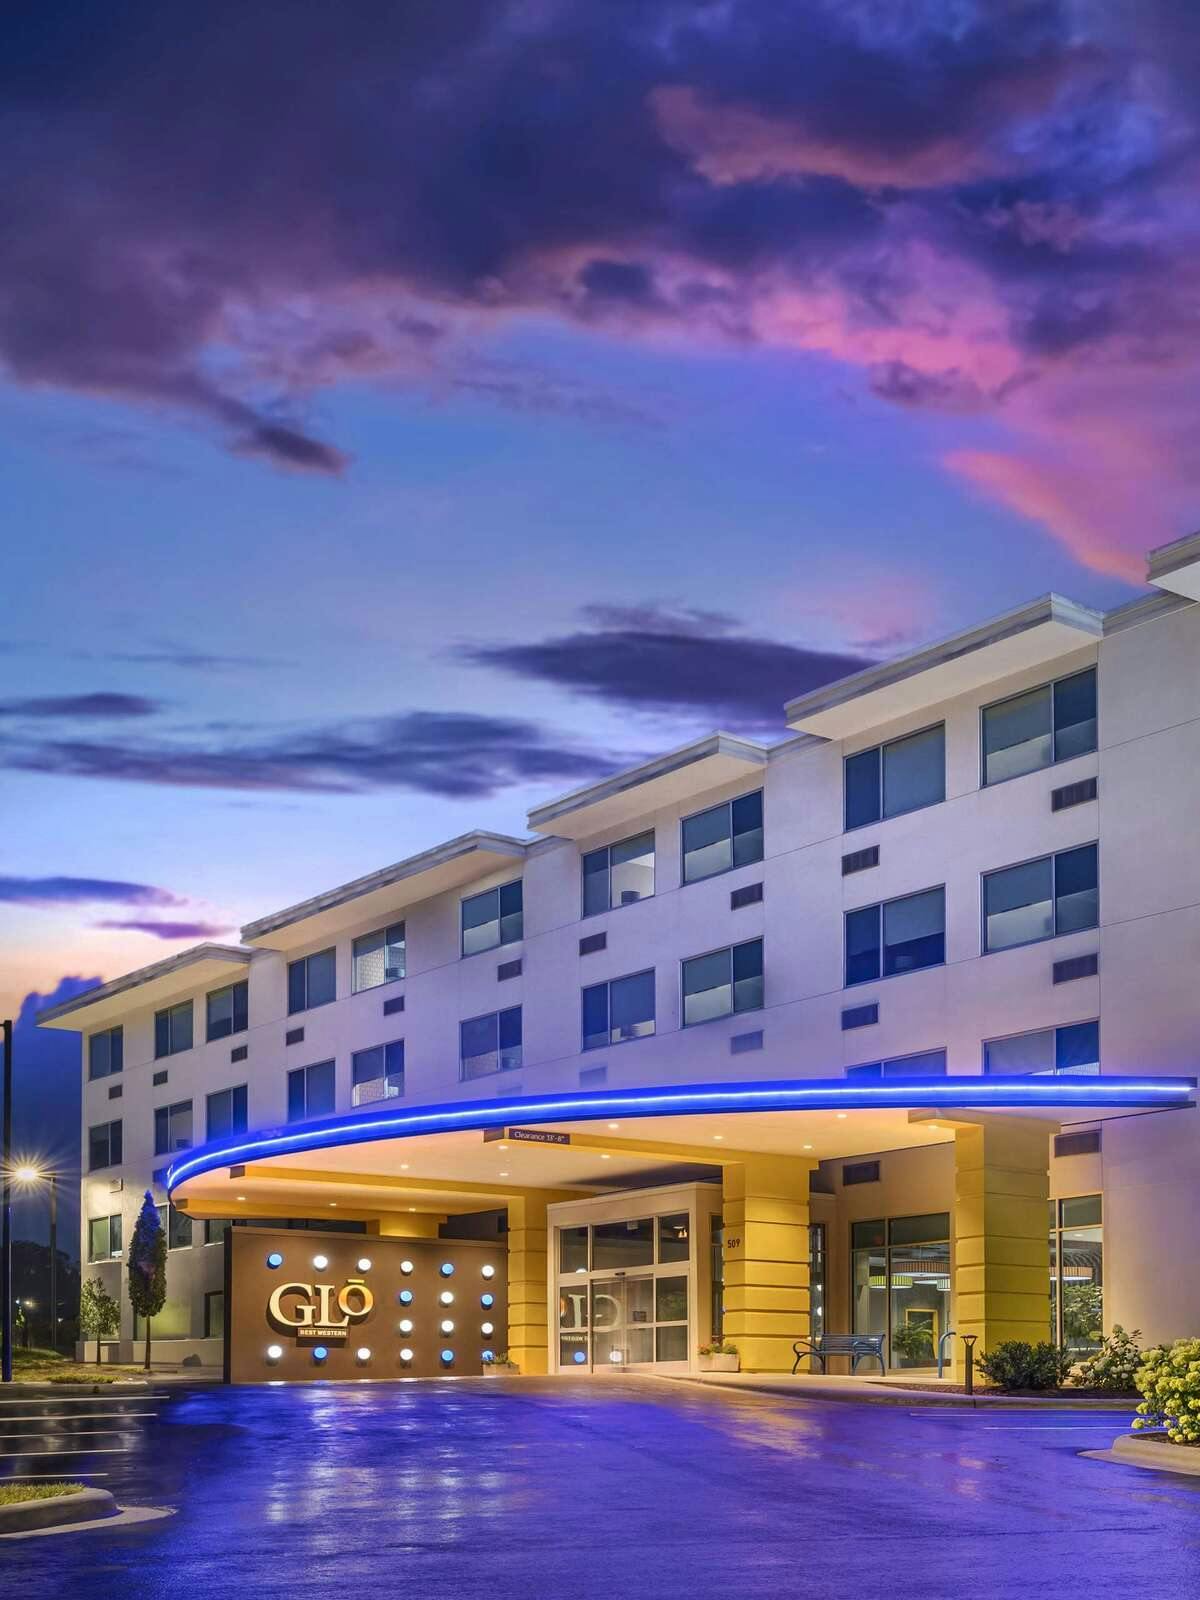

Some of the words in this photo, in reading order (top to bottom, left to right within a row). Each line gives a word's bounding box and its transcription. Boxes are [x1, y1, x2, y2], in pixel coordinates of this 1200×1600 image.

[514, 1131, 545, 1141] Clearance
[727, 1238, 741, 1249] 509
[317, 1329, 347, 1337] WESTERN
